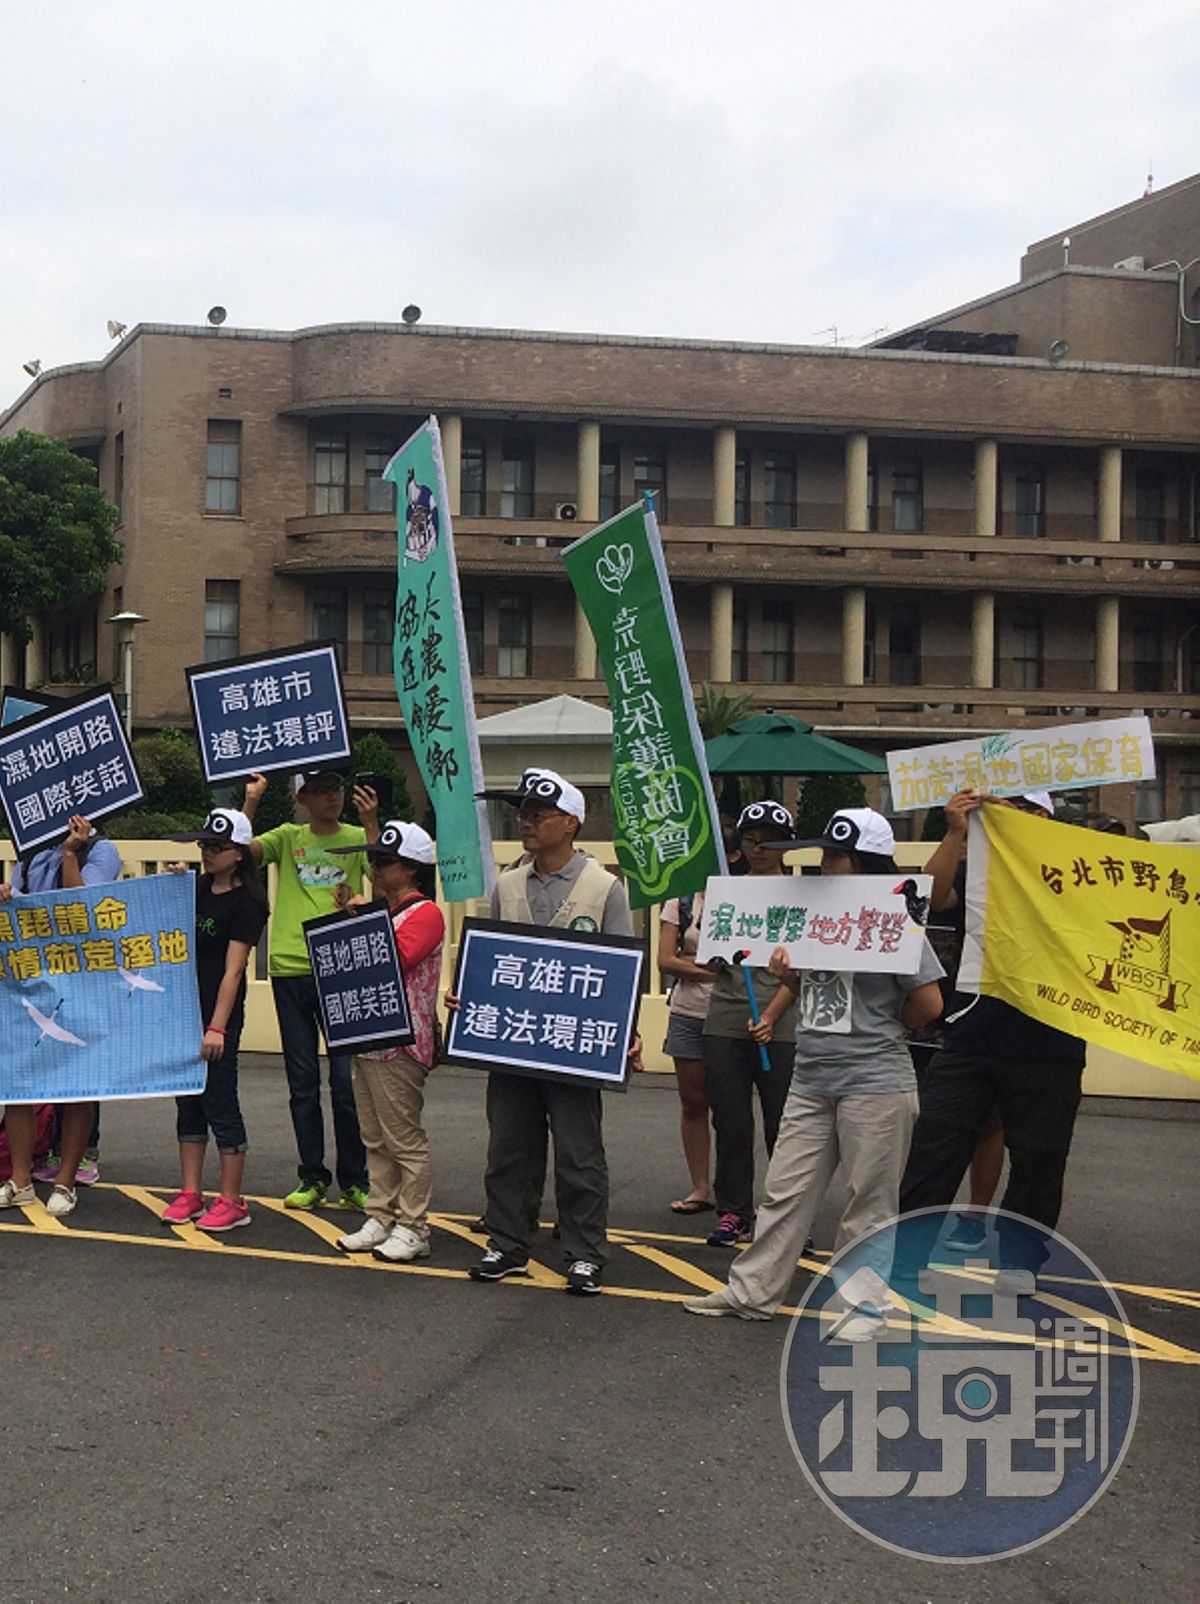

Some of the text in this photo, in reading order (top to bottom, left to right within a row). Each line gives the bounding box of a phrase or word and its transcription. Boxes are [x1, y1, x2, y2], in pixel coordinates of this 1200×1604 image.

[218, 671, 313, 714] 高雄市
[0, 715, 114, 786] 濕地開路
[210, 709, 337, 761] 違法環評
[14, 756, 128, 830] 國際笑話
[1041, 856, 1200, 906] 台北市野鳥
[315, 930, 391, 978] 濕地開路
[491, 954, 608, 1000] 高雄市
[1116, 962, 1167, 991] WBST
[325, 981, 401, 1027] 國際笑話
[1036, 983, 1067, 1008] WILD
[1071, 997, 1101, 1020] BIRD
[1104, 1010, 1157, 1040] SOCIETY
[1159, 1029, 1178, 1046] OF
[463, 1001, 619, 1058] 違法環評
